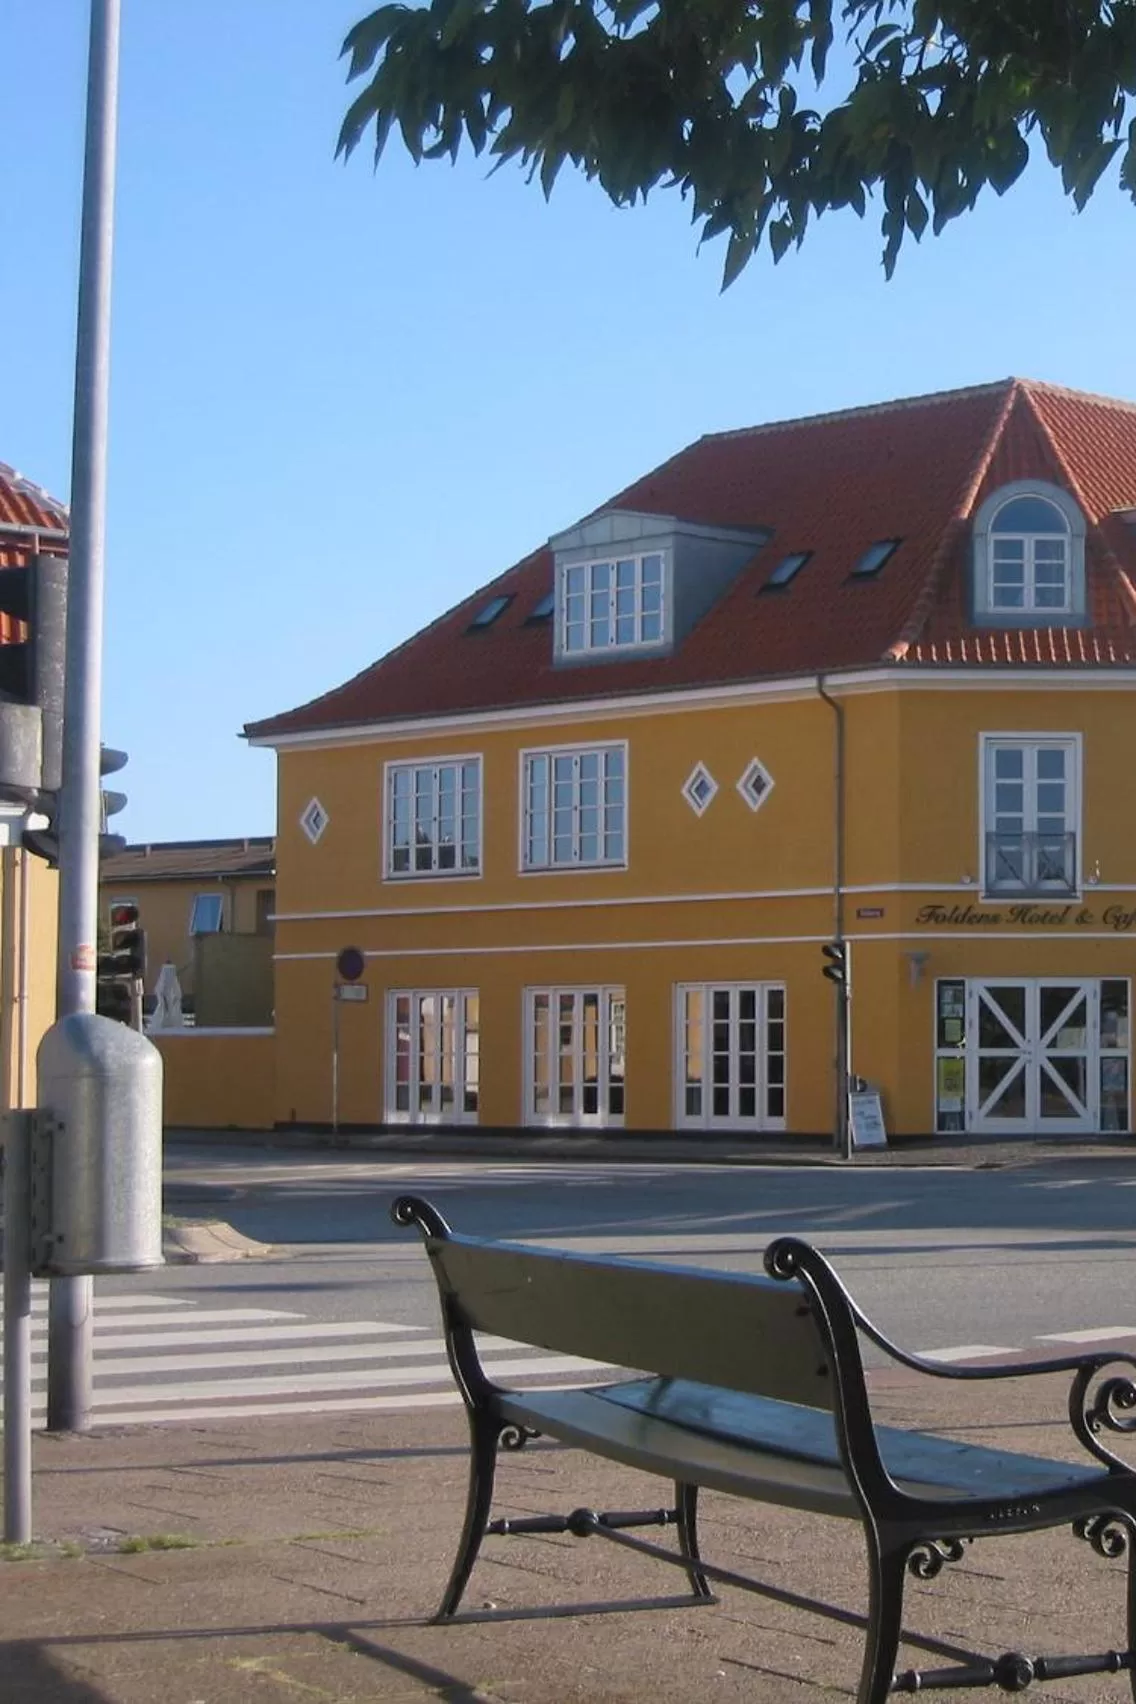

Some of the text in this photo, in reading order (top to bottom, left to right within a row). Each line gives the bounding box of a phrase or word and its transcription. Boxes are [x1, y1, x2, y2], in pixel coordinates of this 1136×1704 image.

[915, 904, 1001, 925] Foldens
[1004, 904, 1072, 925] Hotel
[1075, 909, 1094, 925] &
